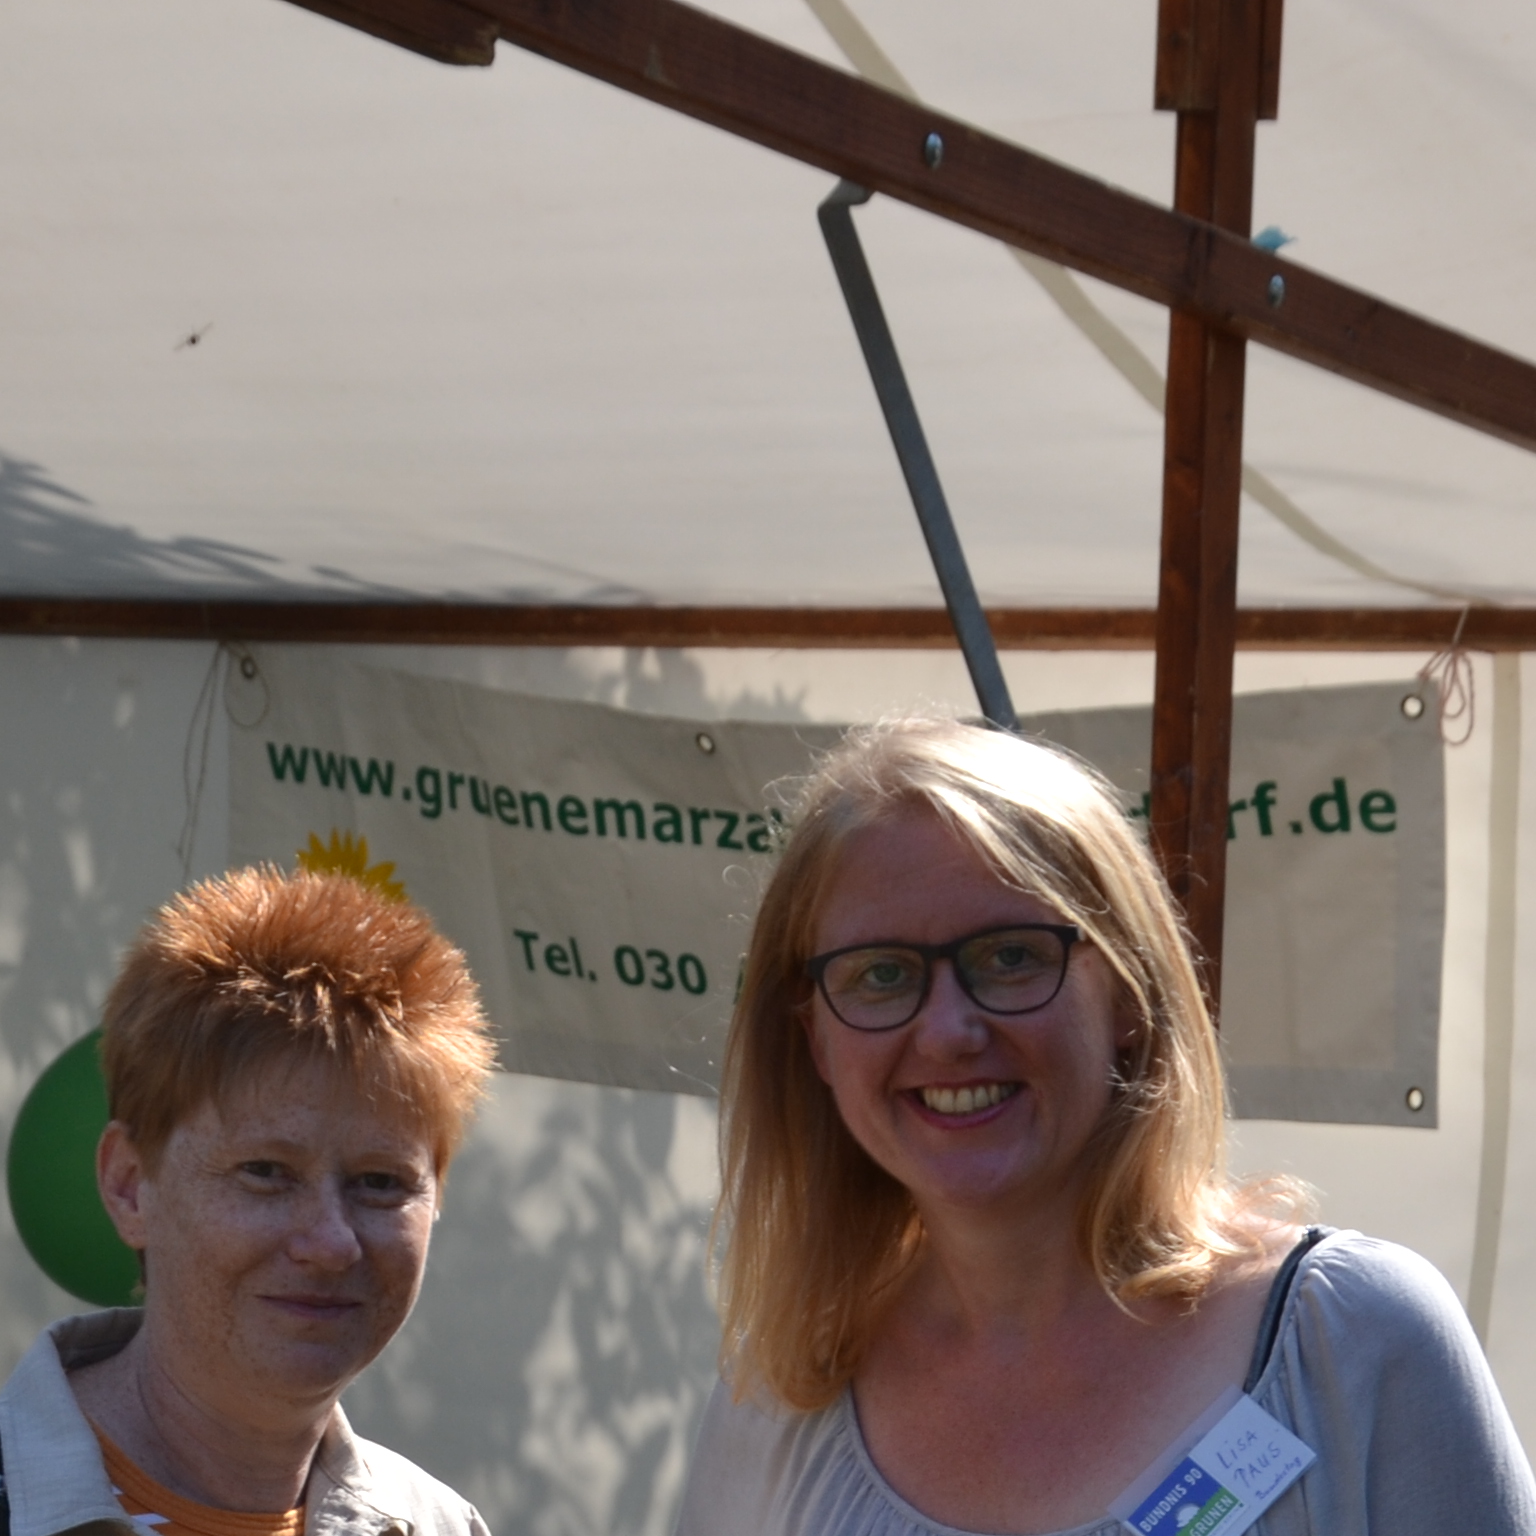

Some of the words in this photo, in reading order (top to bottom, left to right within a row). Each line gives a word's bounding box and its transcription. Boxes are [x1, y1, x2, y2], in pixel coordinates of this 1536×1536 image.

[266, 741, 780, 854] www.gruenemarza
[513, 928, 597, 983] Tel.
[614, 944, 708, 996] 030
[1184, 1467, 1203, 1486] 90
[1233, 1440, 1281, 1489] PAUS
